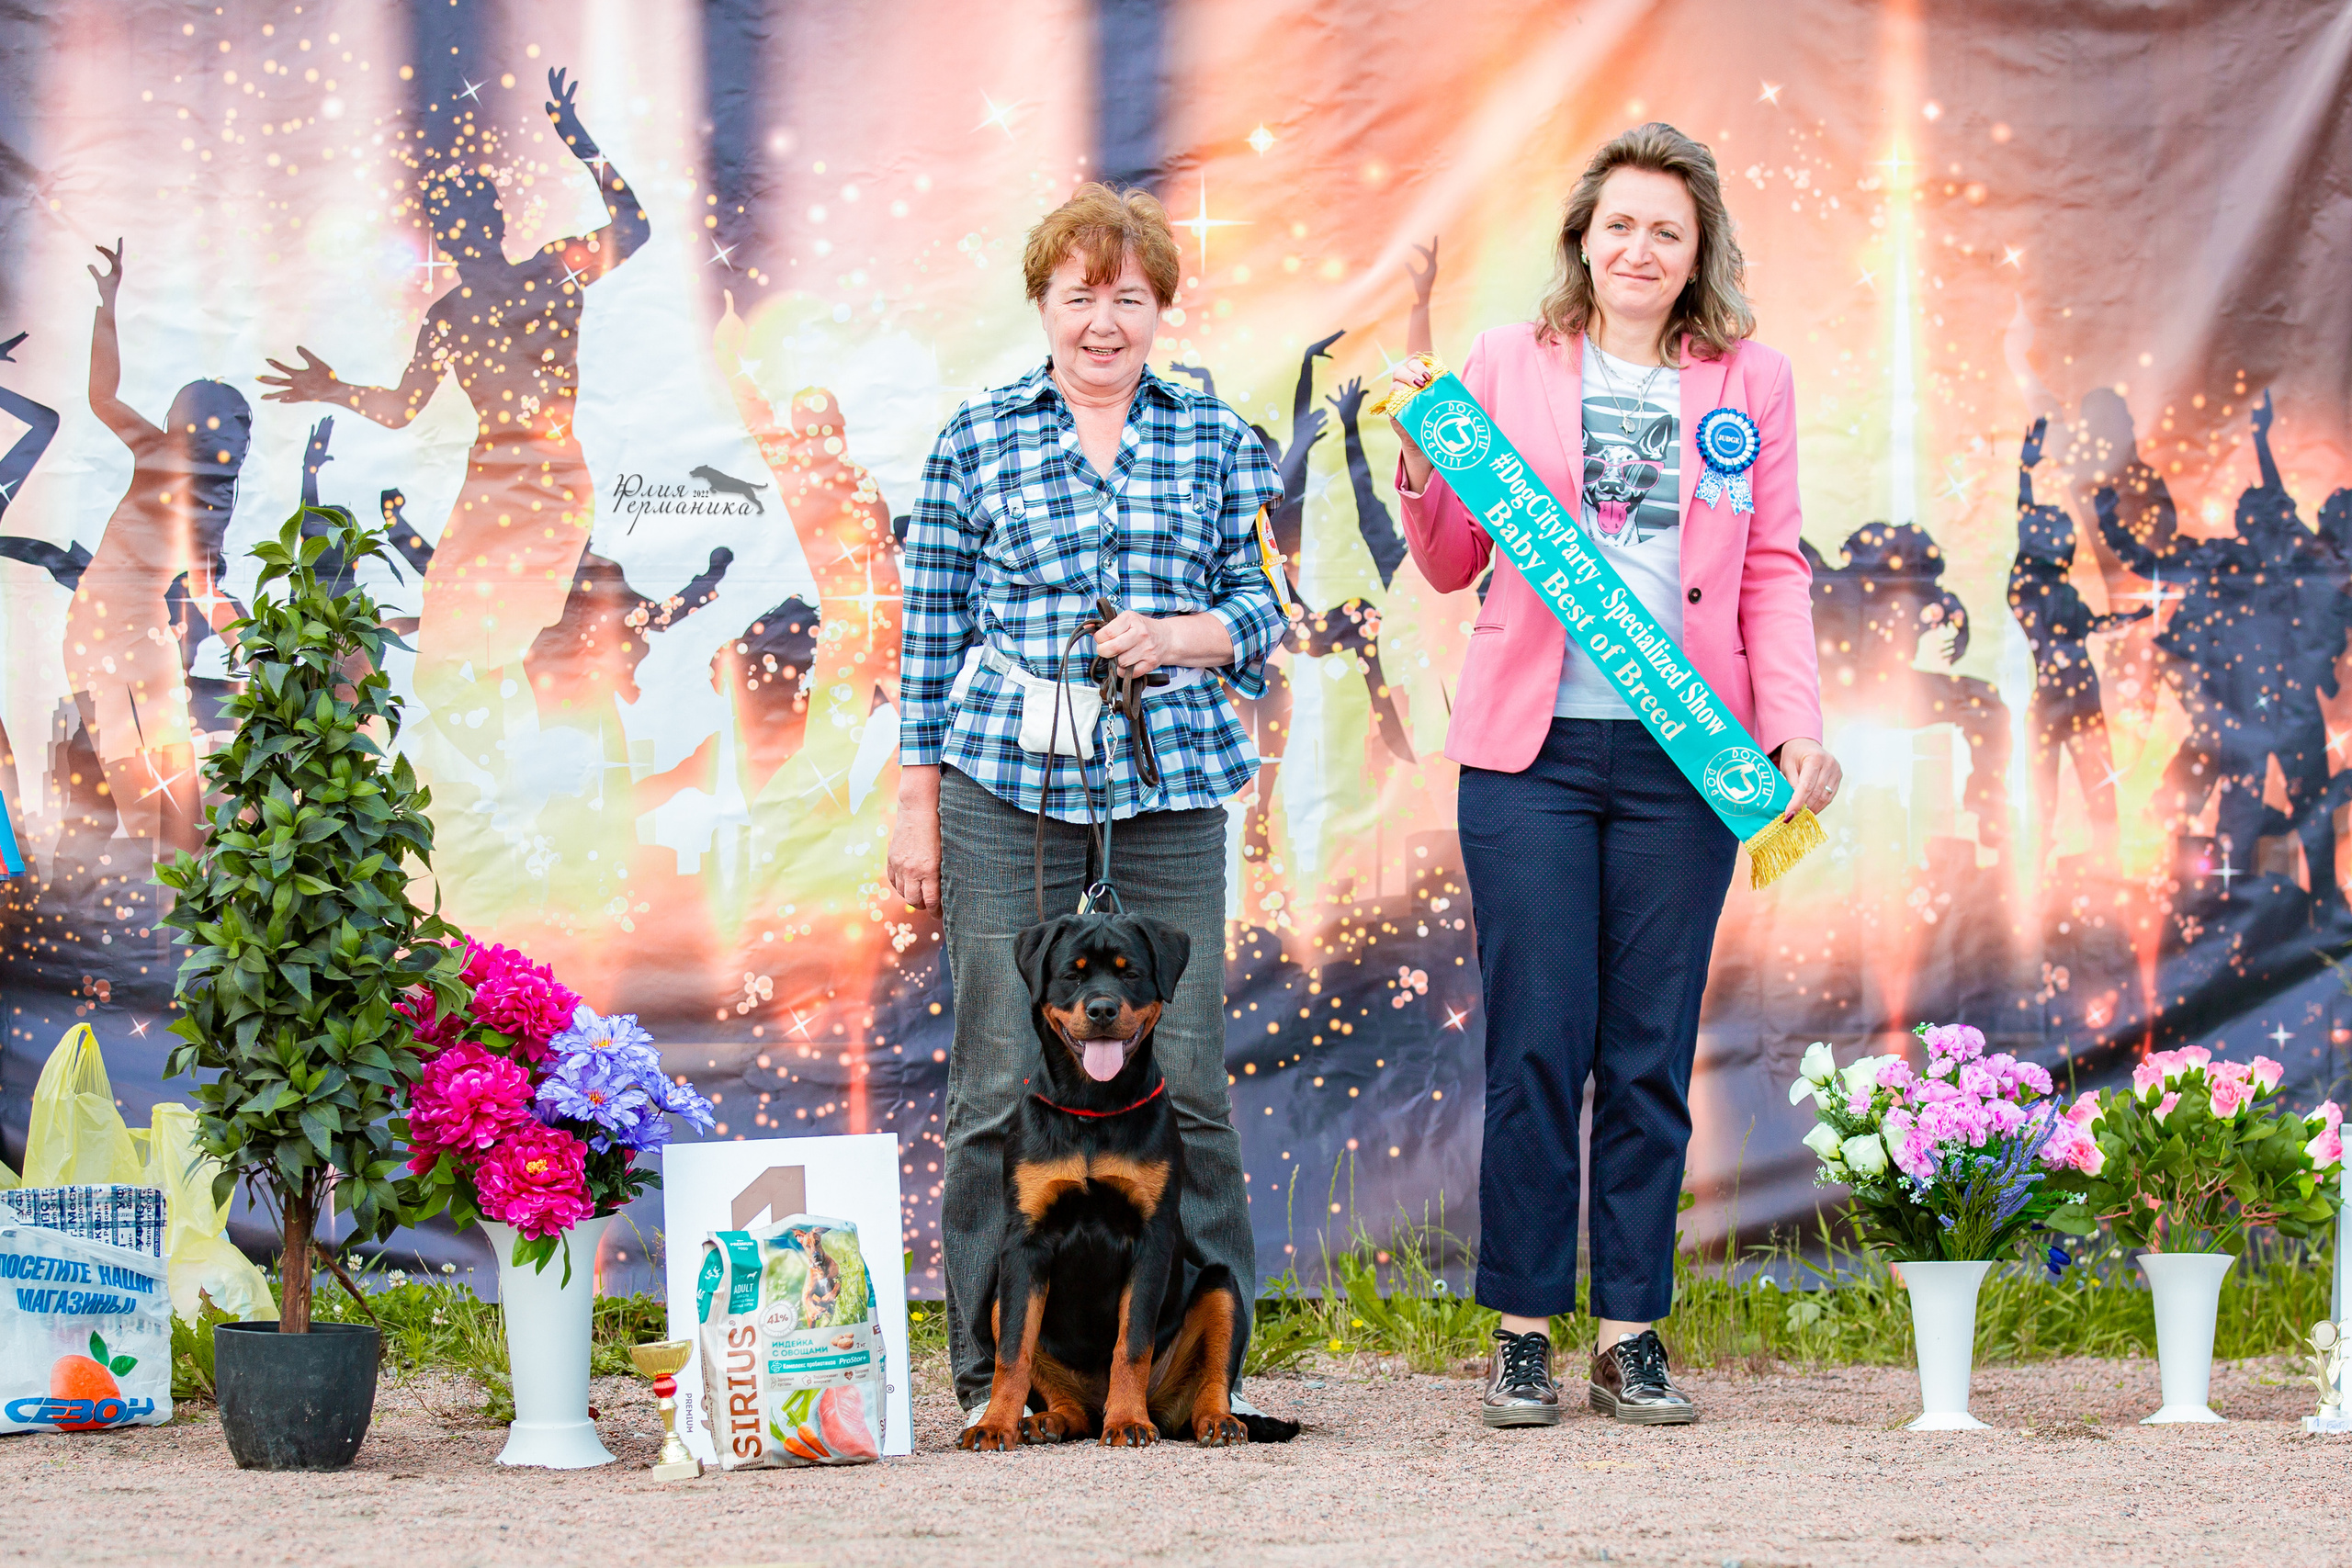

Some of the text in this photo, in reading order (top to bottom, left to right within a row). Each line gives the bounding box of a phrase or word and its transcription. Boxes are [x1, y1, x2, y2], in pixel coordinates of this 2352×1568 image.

[1718, 434, 1740, 445] JUDGE
[1488, 451, 1602, 585] #DogCityParty
[1600, 587, 1693, 690] Specialized
[1678, 682, 1727, 736] Show
[1483, 497, 1687, 741] Baby Best of Breed
[98, 1264, 154, 1294] НАШИ
[733, 1283, 754, 1294] ADULT
[767, 1313, 788, 1324] 41%
[772, 1338, 814, 1348] ИНДЕЙКА
[781, 1347, 828, 1357] ОВОЩАМИ
[839, 1356, 867, 1365] ProStor+
[727, 1325, 762, 1458] SIRIUS
[5, 1397, 154, 1424] СЕЗОН
[685, 1393, 694, 1433] PREMIUM
